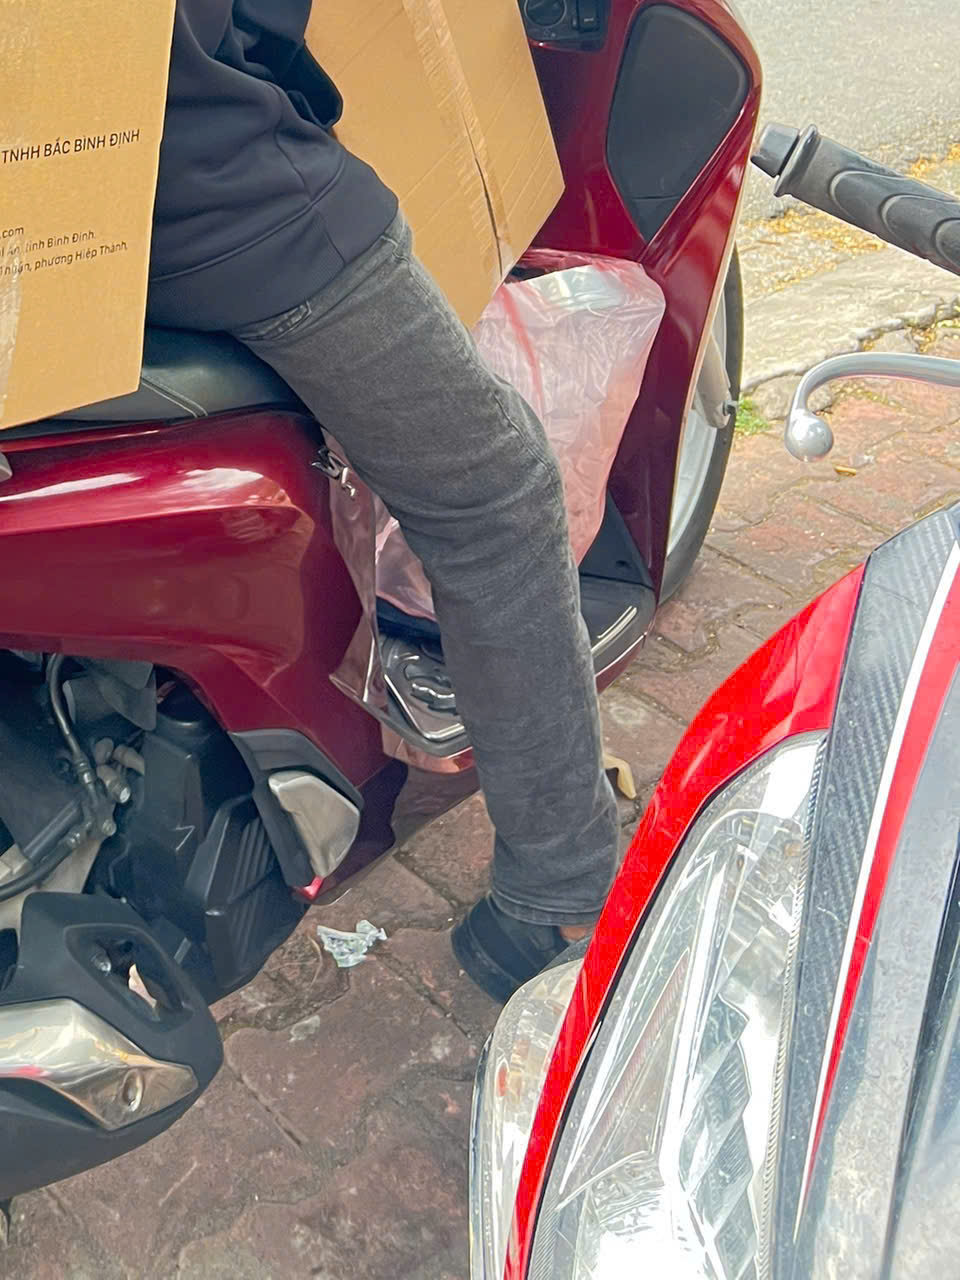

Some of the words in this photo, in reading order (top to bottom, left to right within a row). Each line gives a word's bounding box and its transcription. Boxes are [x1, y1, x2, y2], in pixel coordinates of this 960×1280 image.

[1, 145, 41, 164] TNHH
[44, 137, 71, 157] BẮC
[74, 134, 106, 153] BÌNH
[109, 128, 140, 149] ĐỊNH
